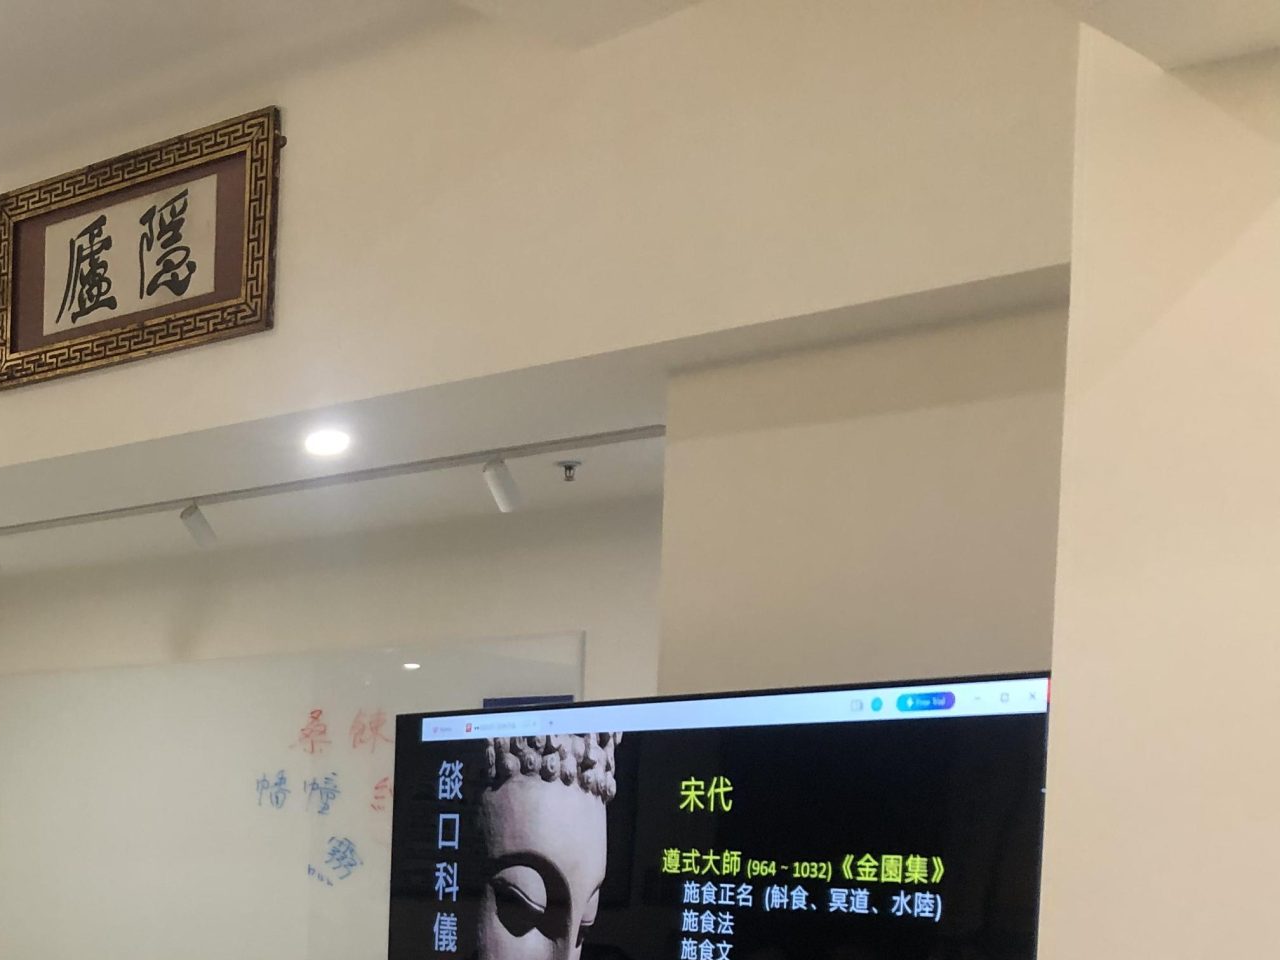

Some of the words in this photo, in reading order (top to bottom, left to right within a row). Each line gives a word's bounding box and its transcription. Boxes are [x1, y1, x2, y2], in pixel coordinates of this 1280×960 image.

[680, 776, 733, 812] 宋代
[662, 848, 741, 876] 遵式大師
[747, 859, 776, 878] (964
[793, 862, 832, 882] 1032)
[683, 880, 753, 907] 施食正名
[682, 909, 734, 934] 施食法
